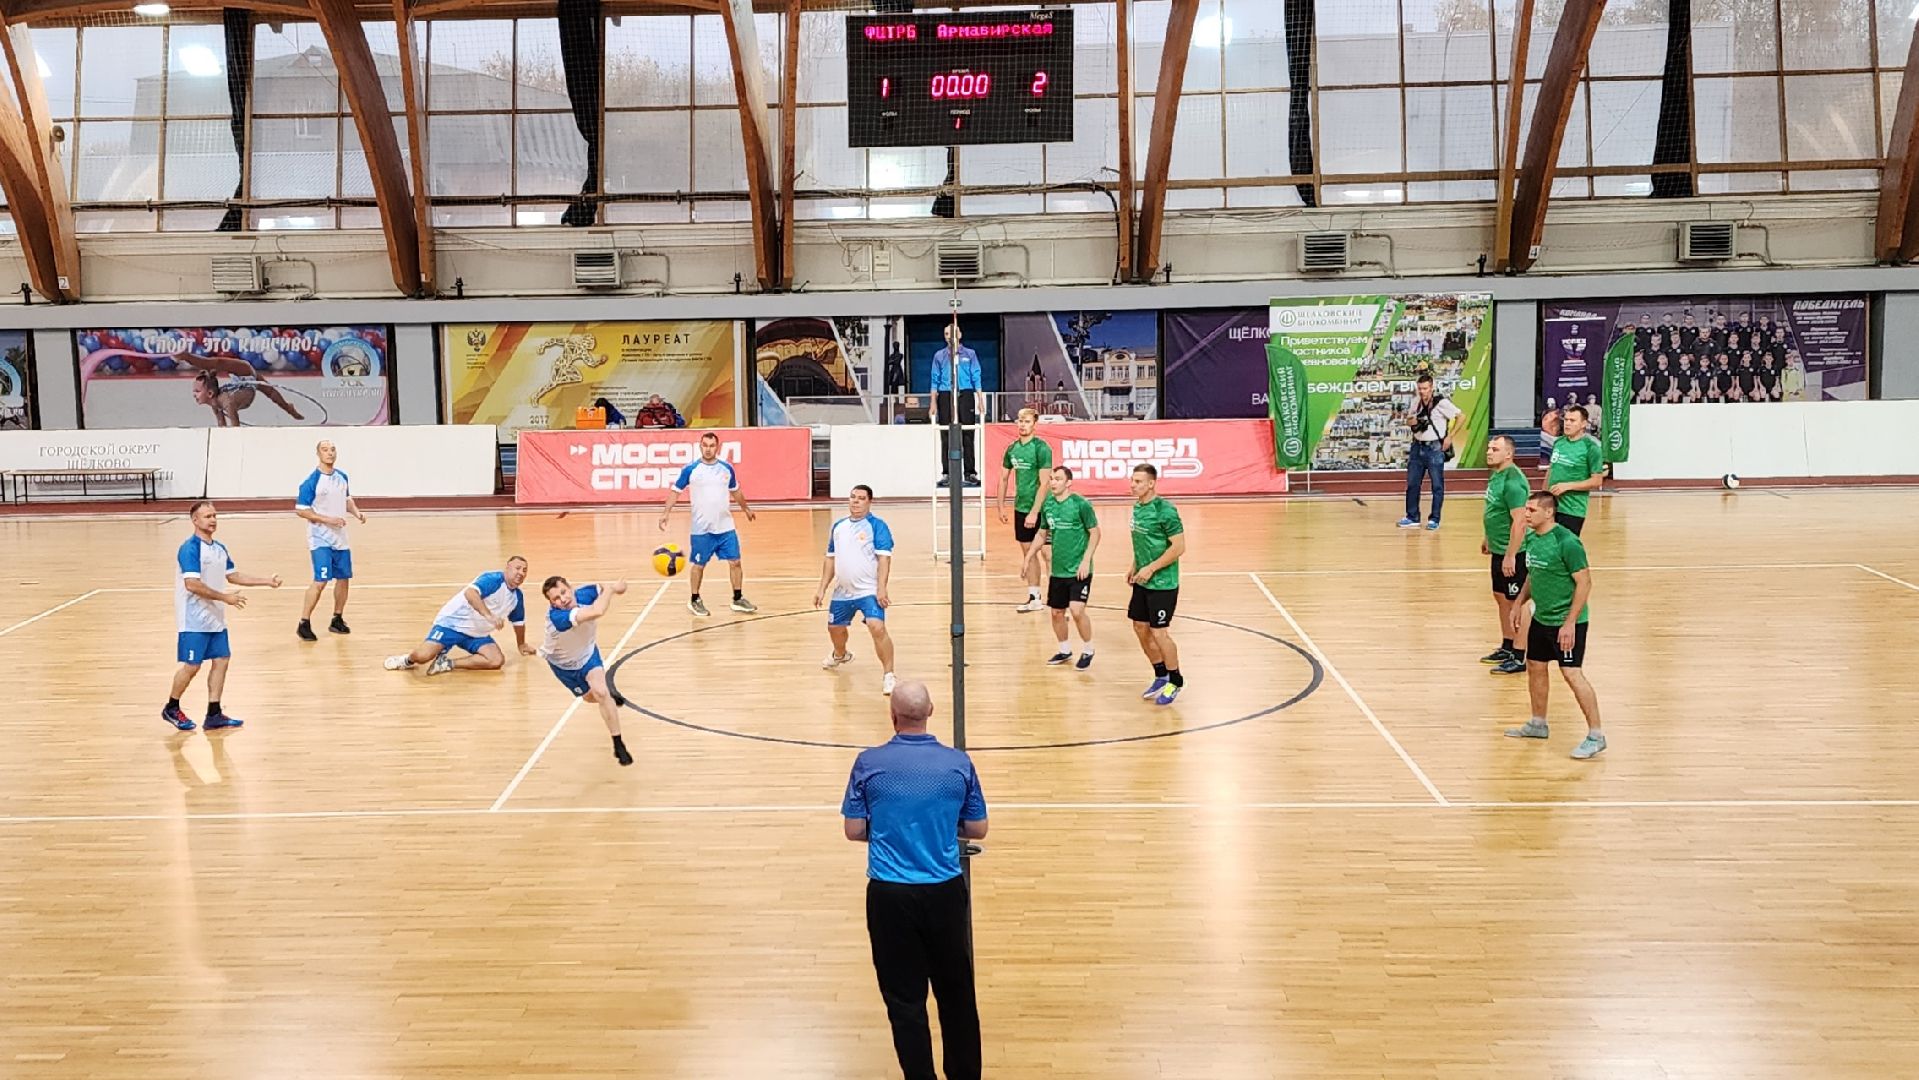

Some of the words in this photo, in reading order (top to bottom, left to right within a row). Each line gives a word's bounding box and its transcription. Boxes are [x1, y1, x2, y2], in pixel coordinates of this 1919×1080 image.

[937, 23, 1053, 39] Армавирская
[882, 78, 889, 97] 1
[1032, 72, 1047, 93] 2
[1793, 300, 1865, 311] ПОБЕДИТЕЛЬ
[621, 333, 691, 345] ЛАУРЕАТ
[1280, 336, 1368, 348] Приветствуем
[1400, 376, 1477, 392] всте!
[529, 415, 550, 425] 2017
[39, 443, 115, 458] ГОРОДСКОЙ
[118, 443, 161, 455] ОКРУГ
[1061, 438, 1198, 459] МОСОБЛ
[1062, 459, 1169, 480] СПОРТ
[321, 567, 328, 579] 2
[1508, 582, 1520, 593] 16
[1158, 609, 1167, 621] 9
